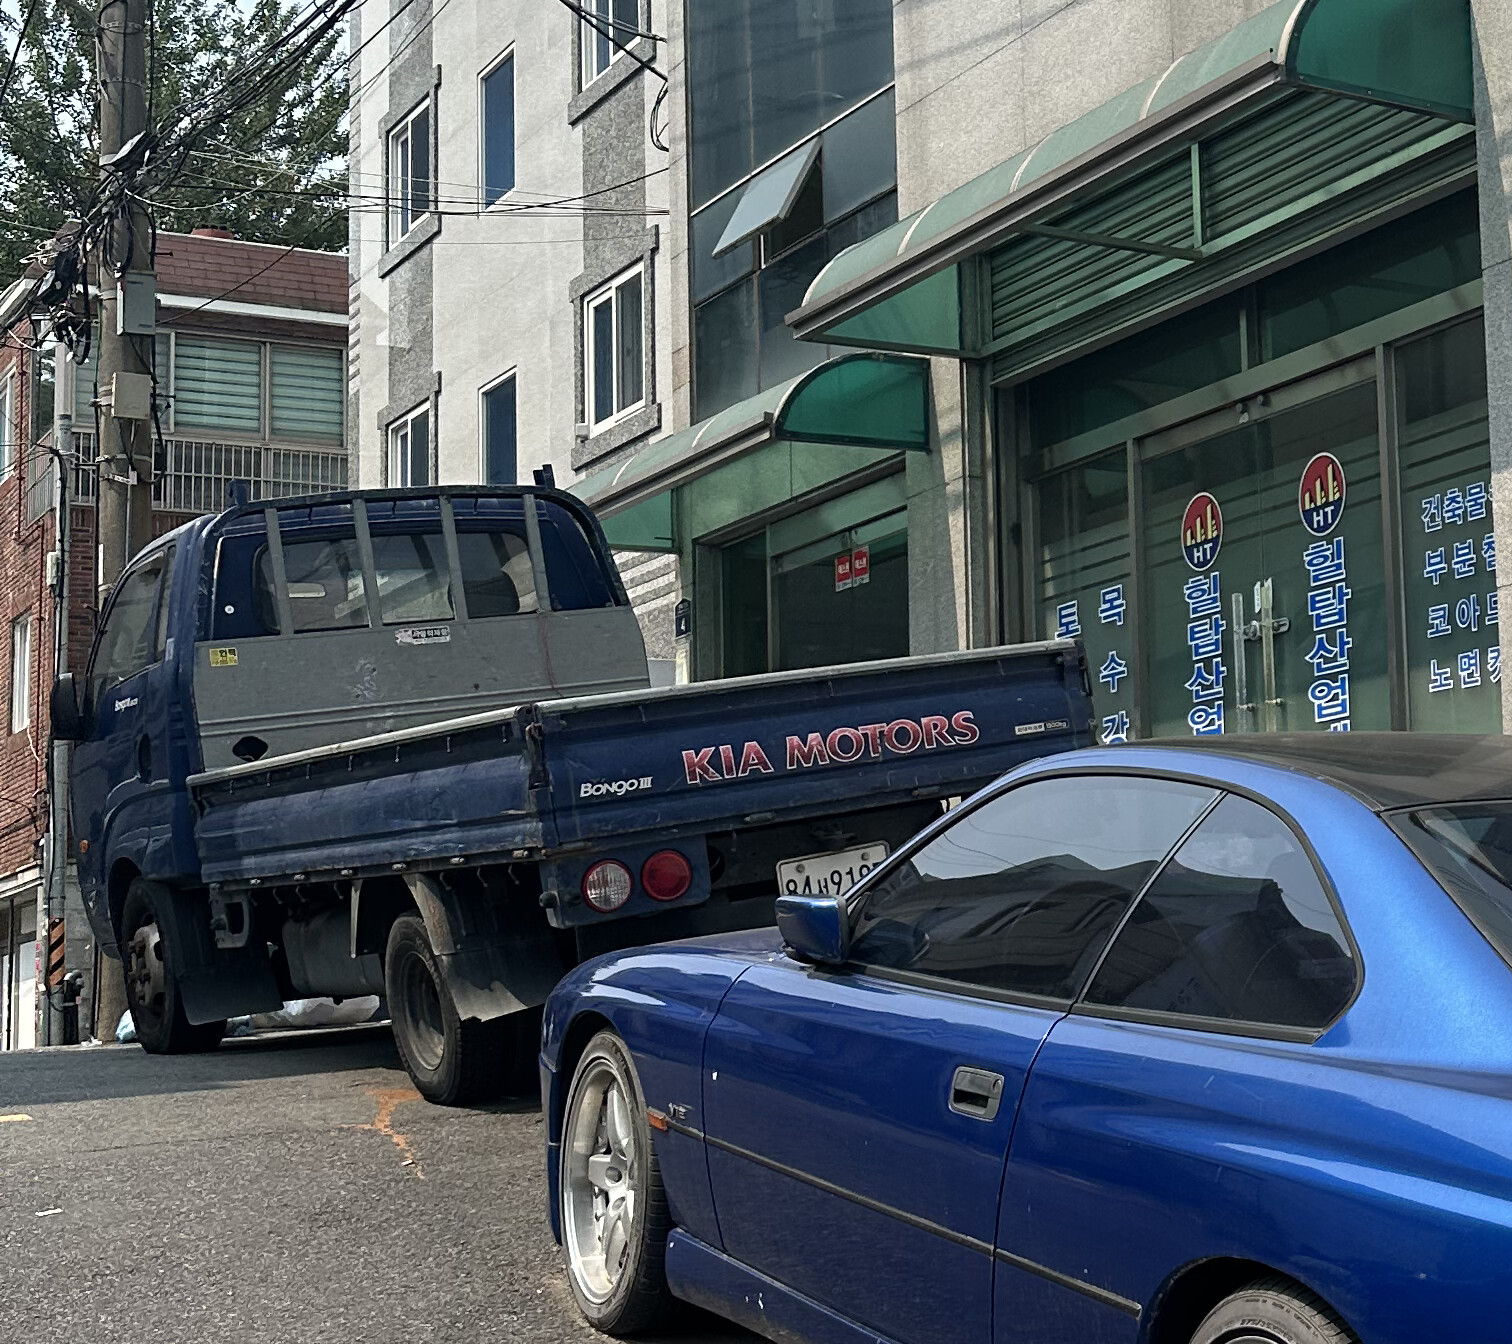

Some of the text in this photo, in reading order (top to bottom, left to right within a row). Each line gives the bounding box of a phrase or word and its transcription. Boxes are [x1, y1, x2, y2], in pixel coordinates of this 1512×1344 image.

[1313, 506, 1335, 529] HT
[1421, 482, 1494, 533] 건축물
[1193, 543, 1213, 565] HT
[682, 710, 980, 784] KIA MOTORS
